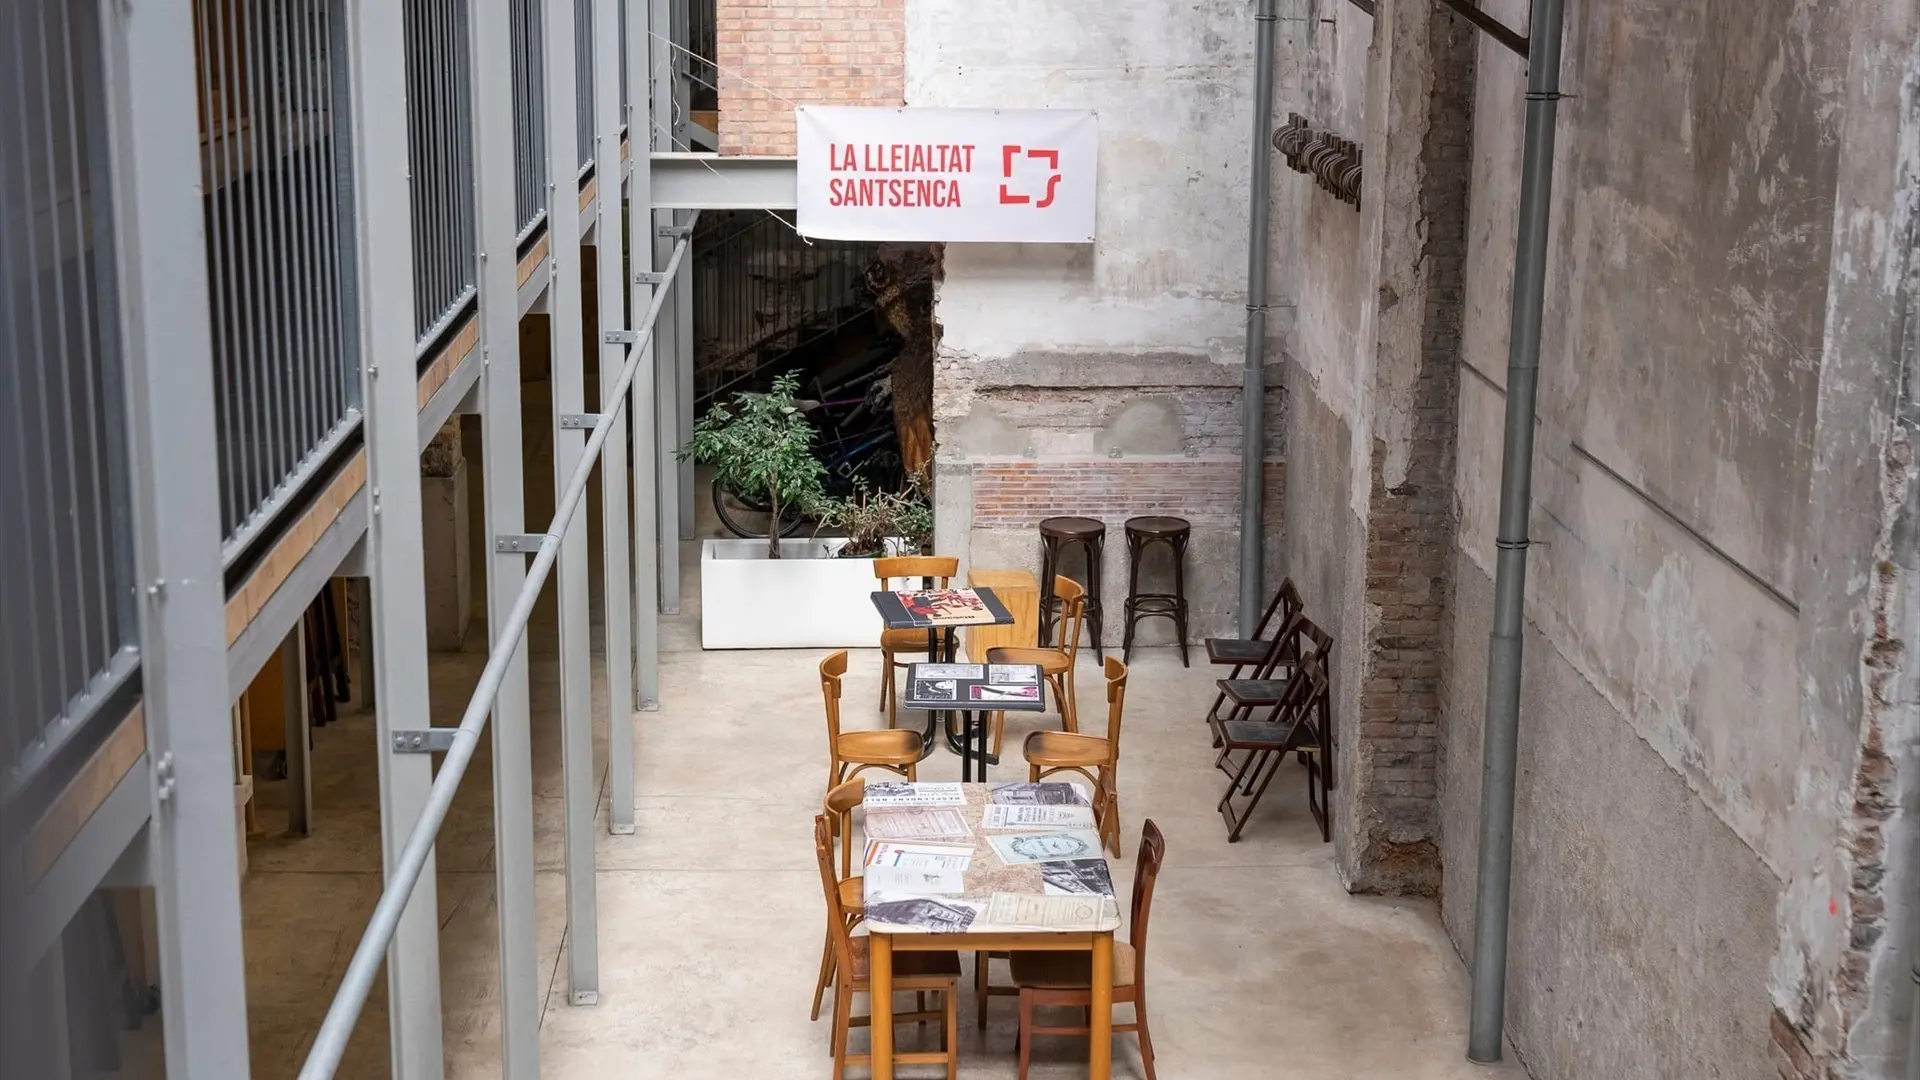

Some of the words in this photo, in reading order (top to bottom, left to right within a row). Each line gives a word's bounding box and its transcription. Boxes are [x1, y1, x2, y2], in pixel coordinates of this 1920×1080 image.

[830, 144, 857, 171] LA
[864, 144, 975, 172] LLEIALTAT
[829, 178, 961, 207] SANTSENCA
